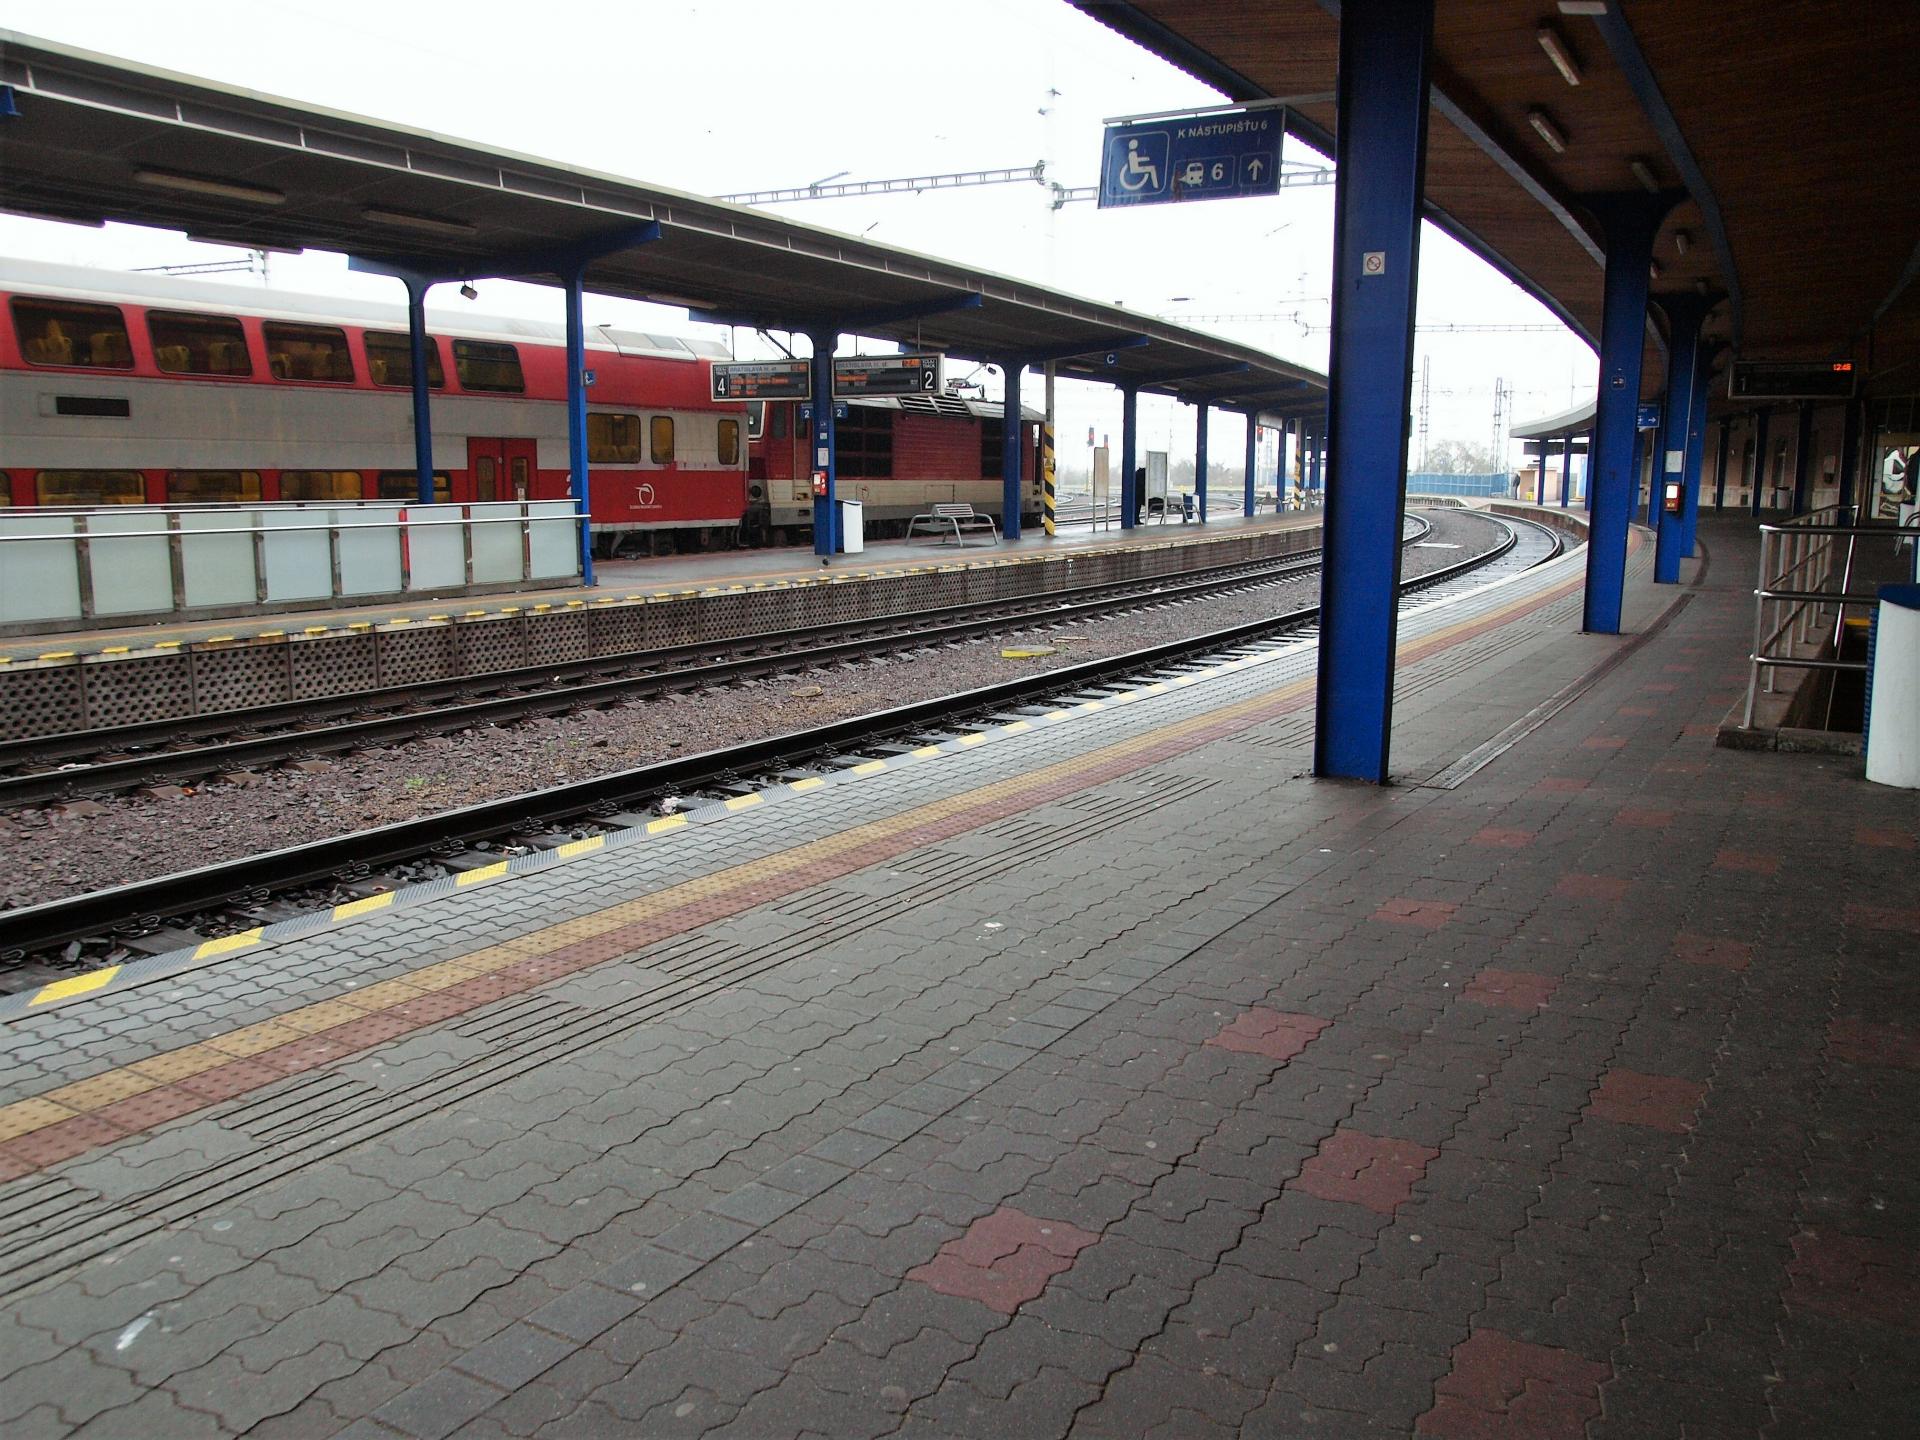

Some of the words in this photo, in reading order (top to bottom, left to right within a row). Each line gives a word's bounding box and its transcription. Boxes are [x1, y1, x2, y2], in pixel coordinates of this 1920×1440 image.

[1177, 128, 1186, 138] K
[1260, 121, 1268, 131] 6
[1211, 163, 1224, 181] 6
[1106, 354, 1115, 364] C
[717, 377, 726, 395] 4
[924, 371, 935, 389] 2
[804, 409, 810, 419] 2
[836, 408, 842, 417] 2
